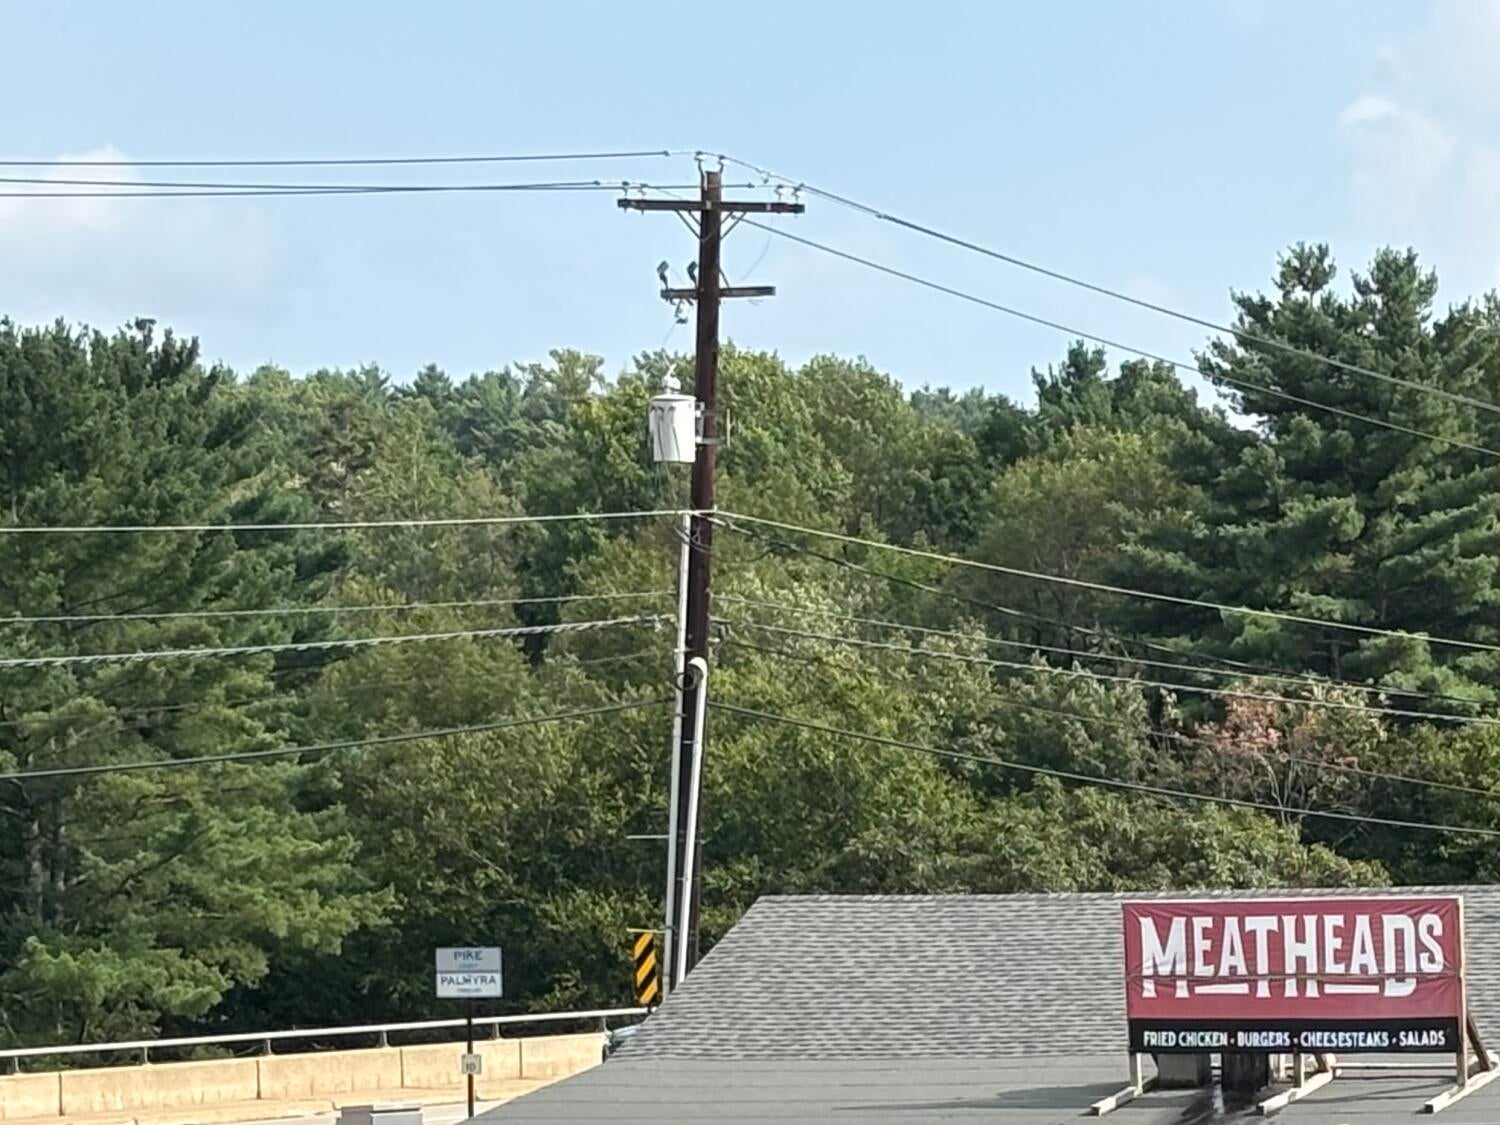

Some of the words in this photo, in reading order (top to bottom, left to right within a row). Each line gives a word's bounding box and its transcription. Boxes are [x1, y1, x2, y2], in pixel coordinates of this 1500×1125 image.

[453, 951, 483, 961] PIKE
[1139, 913, 1445, 998] MEATHEADS
[440, 975, 497, 986] PALMYRA
[1143, 1031, 1176, 1047] FRIED
[1178, 1031, 1228, 1047] CHICKEN
[1237, 1031, 1291, 1047] BURGERS
[1300, 1031, 1389, 1048] CHEESESTEAKS
[1399, 1030, 1446, 1046] SALADS
